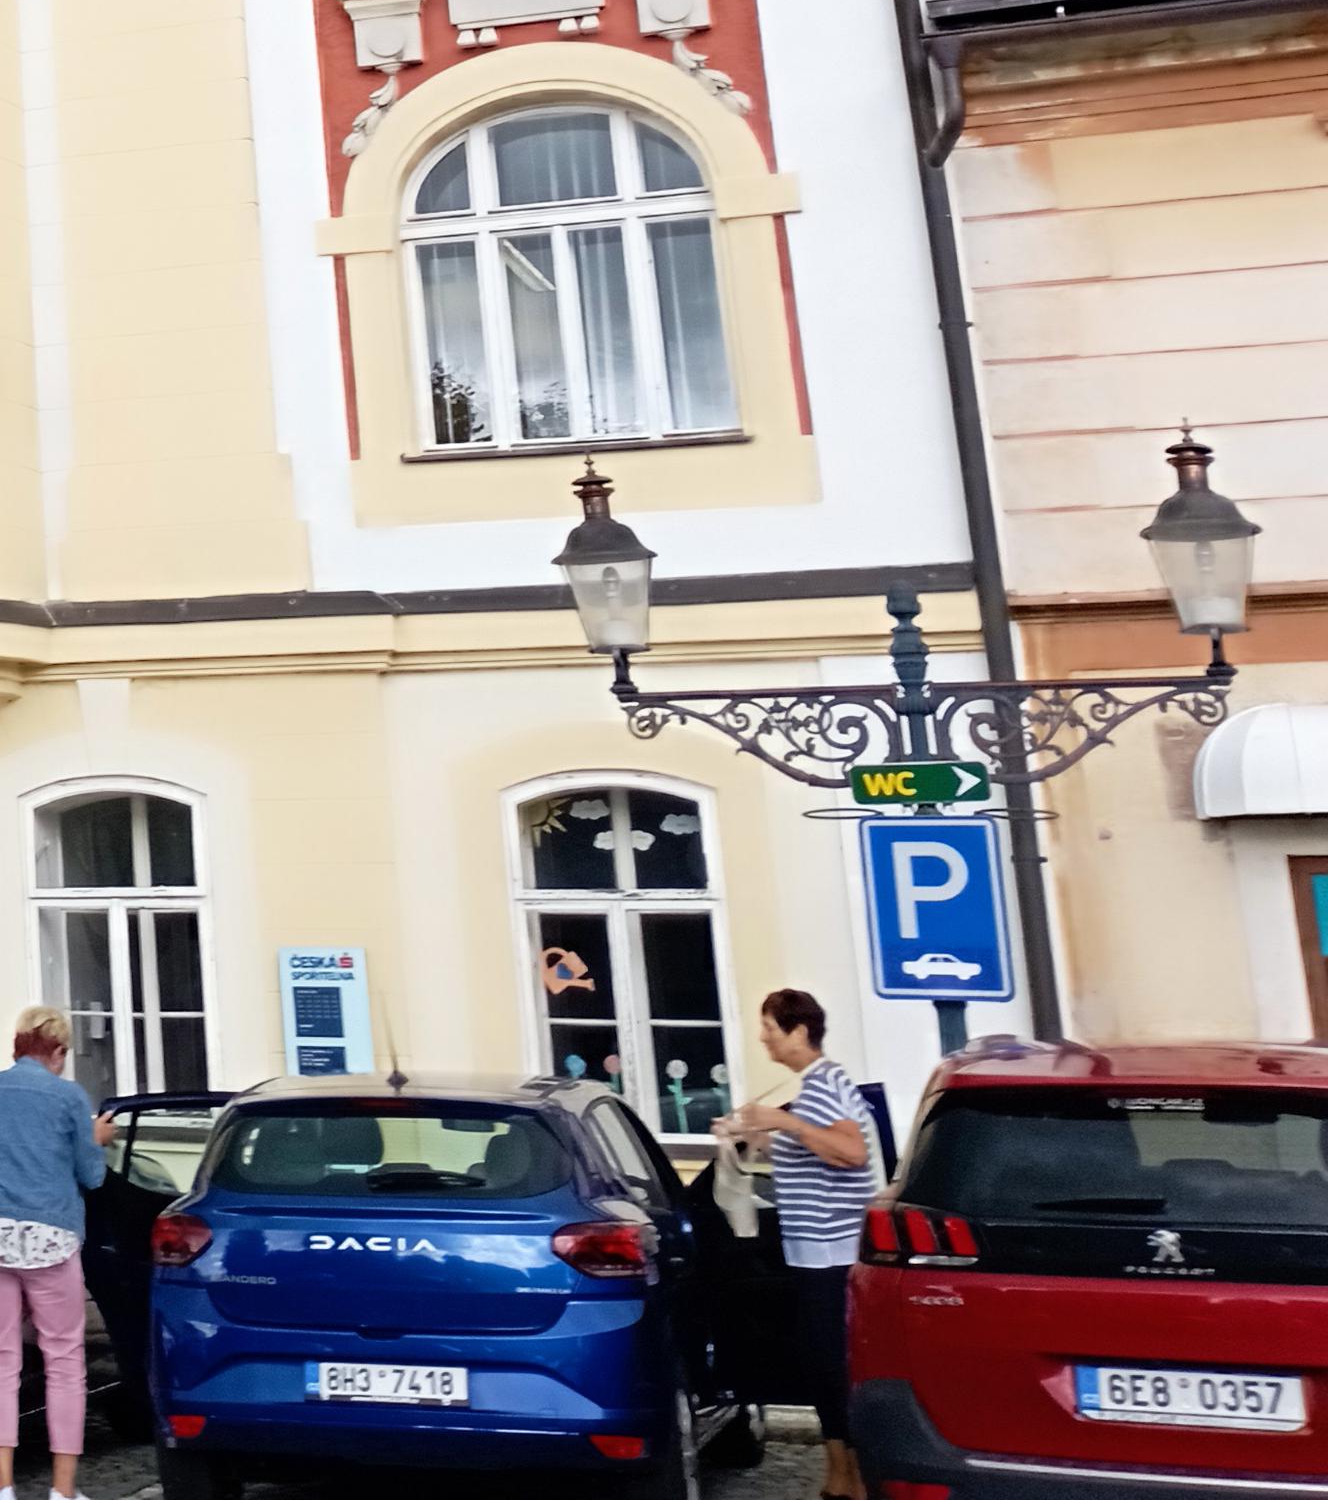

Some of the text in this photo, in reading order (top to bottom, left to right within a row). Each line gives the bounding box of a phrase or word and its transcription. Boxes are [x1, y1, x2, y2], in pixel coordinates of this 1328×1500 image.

[862, 771, 917, 797] WC
[890, 841, 969, 939] P
[289, 953, 337, 968] ČESKÁ
[309, 1235, 439, 1251] DACIA
[327, 1367, 454, 1396] 8H3 7418
[1108, 1374, 1171, 1408] 6E8
[1198, 1378, 1283, 1415] 0357
